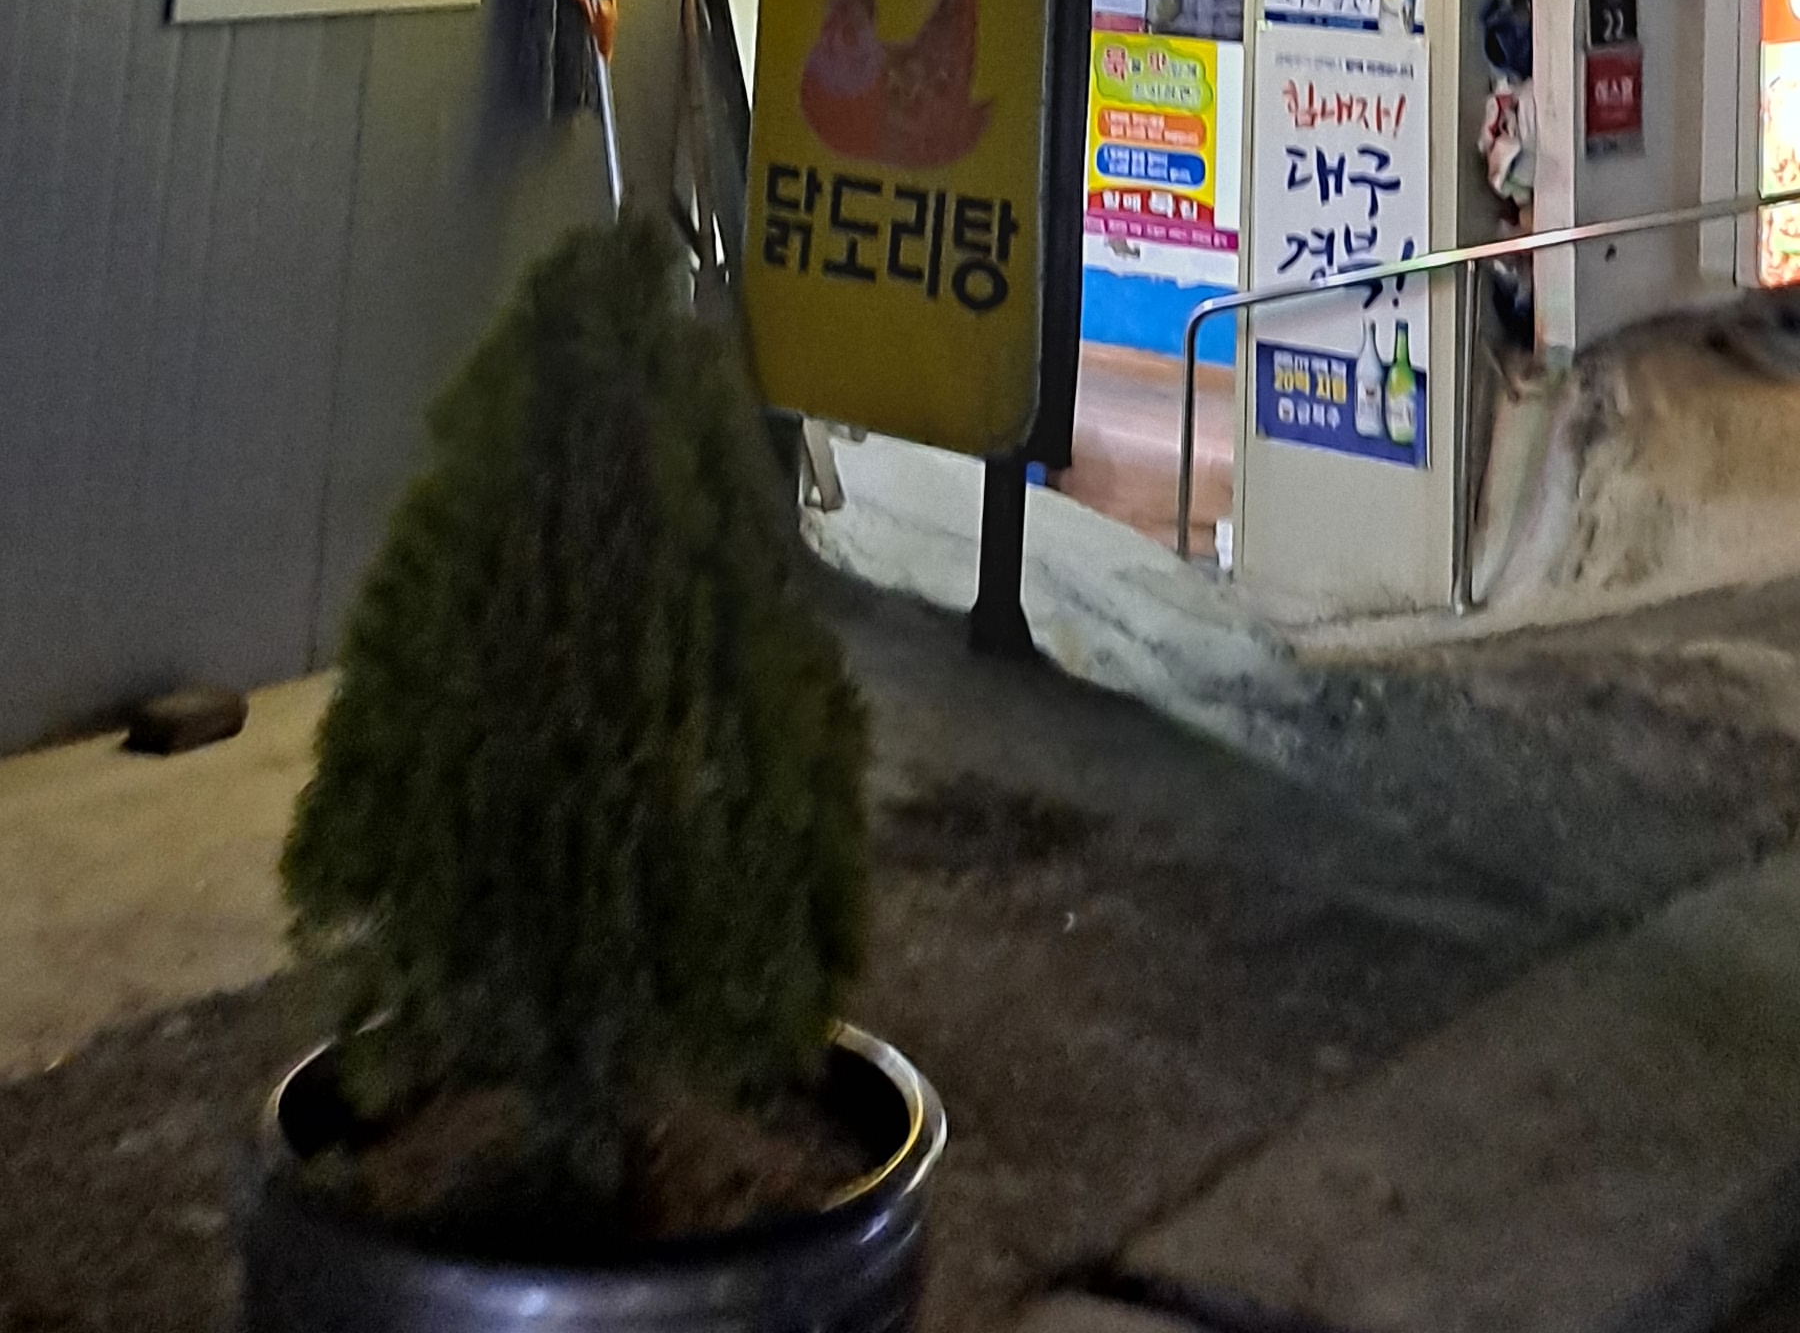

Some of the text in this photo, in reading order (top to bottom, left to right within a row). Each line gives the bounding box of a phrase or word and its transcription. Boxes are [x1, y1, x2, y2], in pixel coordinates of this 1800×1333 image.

[1282, 79, 1406, 139] 힘내자!
[1285, 144, 1401, 219] 대구
[763, 161, 1019, 314] 닭도리탕
[1277, 223, 1415, 309] 경북!
